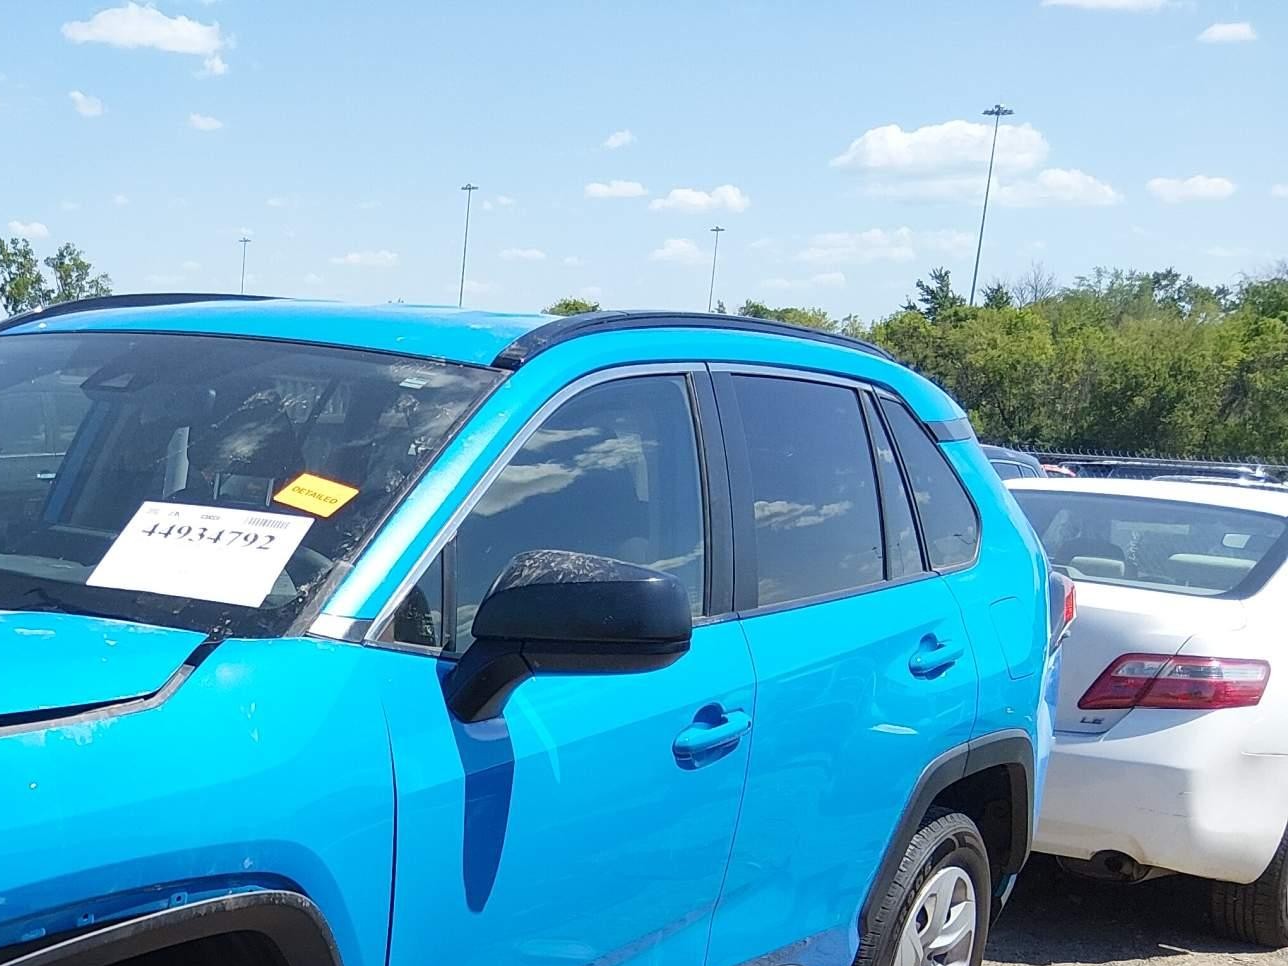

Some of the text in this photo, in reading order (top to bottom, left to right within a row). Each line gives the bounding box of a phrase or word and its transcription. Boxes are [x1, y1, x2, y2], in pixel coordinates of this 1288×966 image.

[291, 486, 338, 505] DETAILED
[141, 522, 276, 550] 44934792
[1079, 716, 1104, 725] LE
